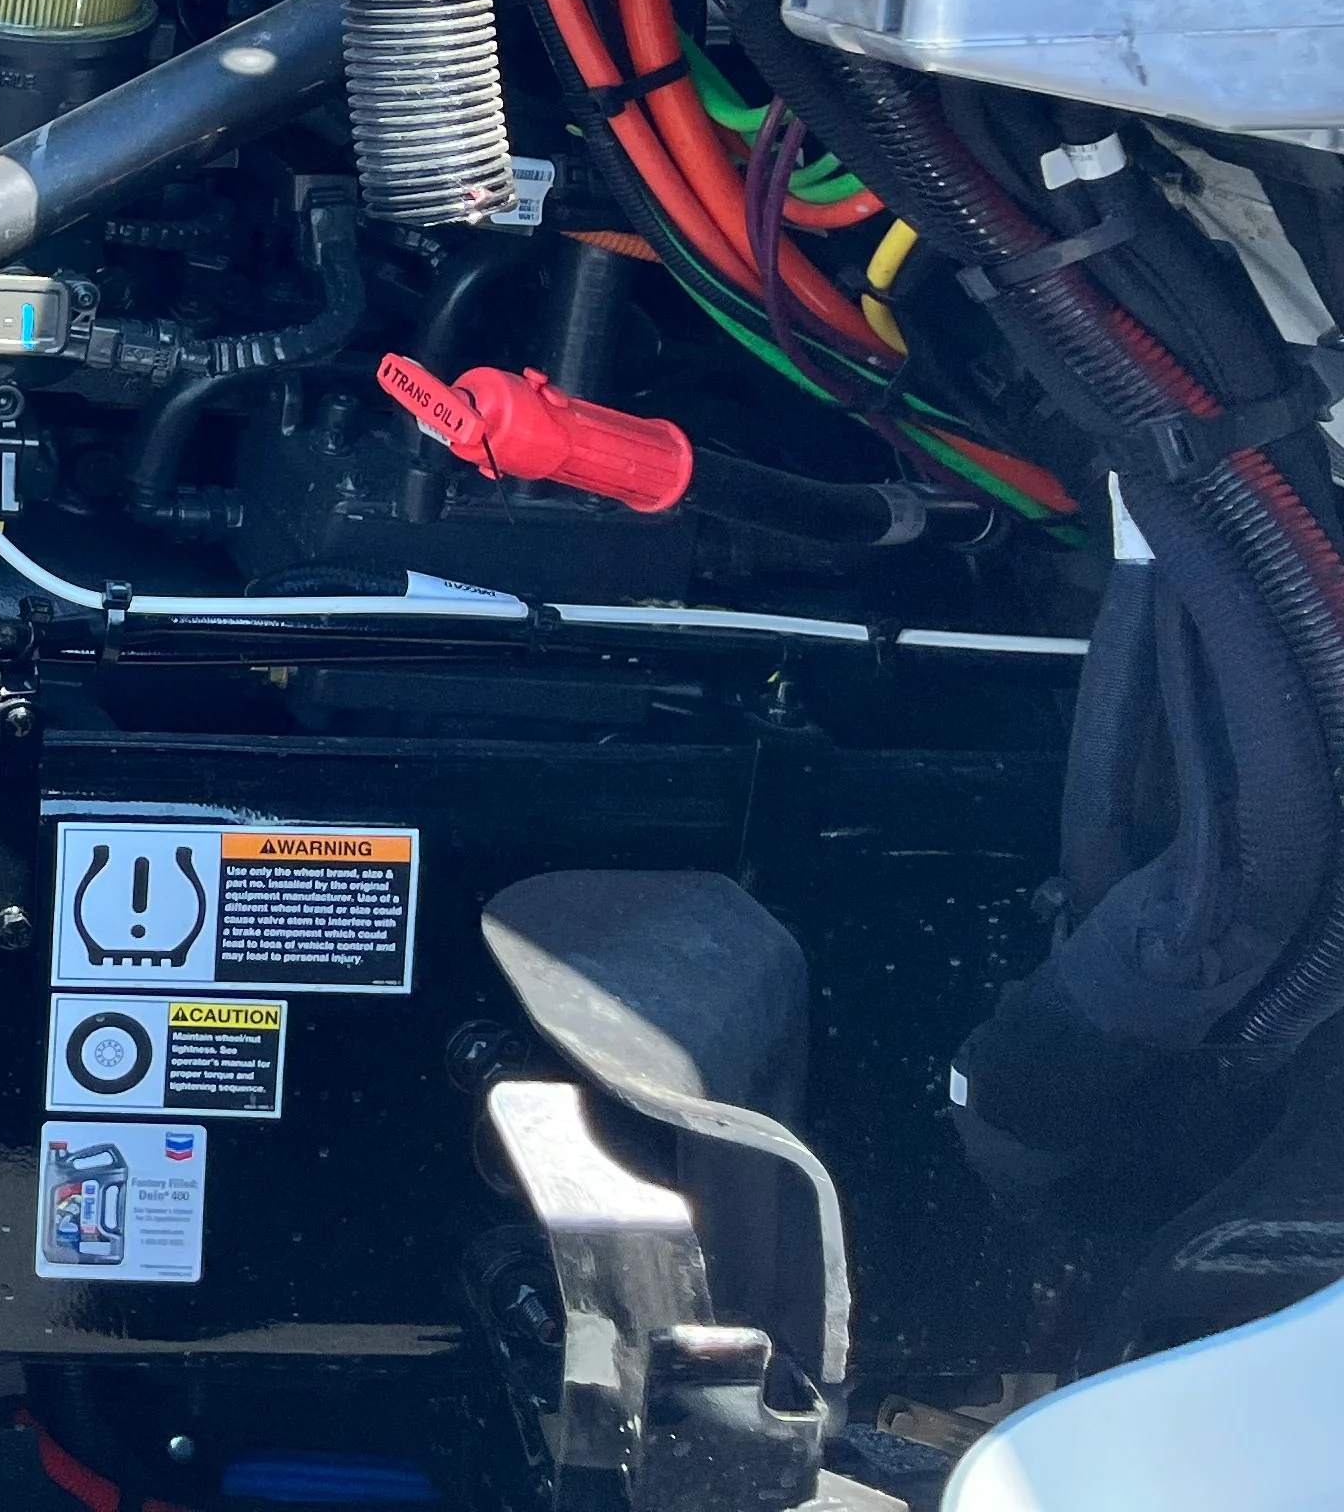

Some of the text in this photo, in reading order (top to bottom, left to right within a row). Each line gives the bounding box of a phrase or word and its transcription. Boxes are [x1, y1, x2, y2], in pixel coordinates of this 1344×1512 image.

[392, 368, 452, 428] TRANS OIL
[277, 840, 372, 856] WARNING
[226, 866, 247, 876] Use
[249, 867, 273, 879] only
[274, 868, 292, 877] the
[294, 868, 324, 877] wheel
[327, 869, 360, 879] brand,
[362, 870, 384, 879] size
[226, 880, 247, 889] part
[268, 880, 312, 889] installed
[315, 880, 328, 891] by
[330, 880, 347, 890] the
[349, 881, 389, 892] original
[225, 892, 281, 901] equipment
[282, 893, 354, 902] manufacturer.
[357, 894, 377, 903] Use
[379, 894, 391, 903] of
[225, 903, 268, 912] different
[271, 904, 301, 913] wheel
[303, 905, 333, 914] brand
[350, 906, 370, 914] size
[373, 906, 402, 915] could
[224, 916, 396, 927] cause valve stem to interfere with
[223, 927, 387, 939] a brake component which could
[222, 939, 395, 952] lead to loss of vehicle control and
[222, 952, 364, 965] may lead to personal injury.
[190, 1008, 278, 1025] CAUTION
[173, 1032, 261, 1043] Maintain wheel/nut
[172, 1045, 237, 1055] tightness. See
[171, 1058, 270, 1068] operator's manual for
[204, 1071, 234, 1080] torque
[236, 1072, 254, 1080] and
[170, 1082, 266, 1093] tightening sequence.
[171, 1191, 190, 1201] 400
